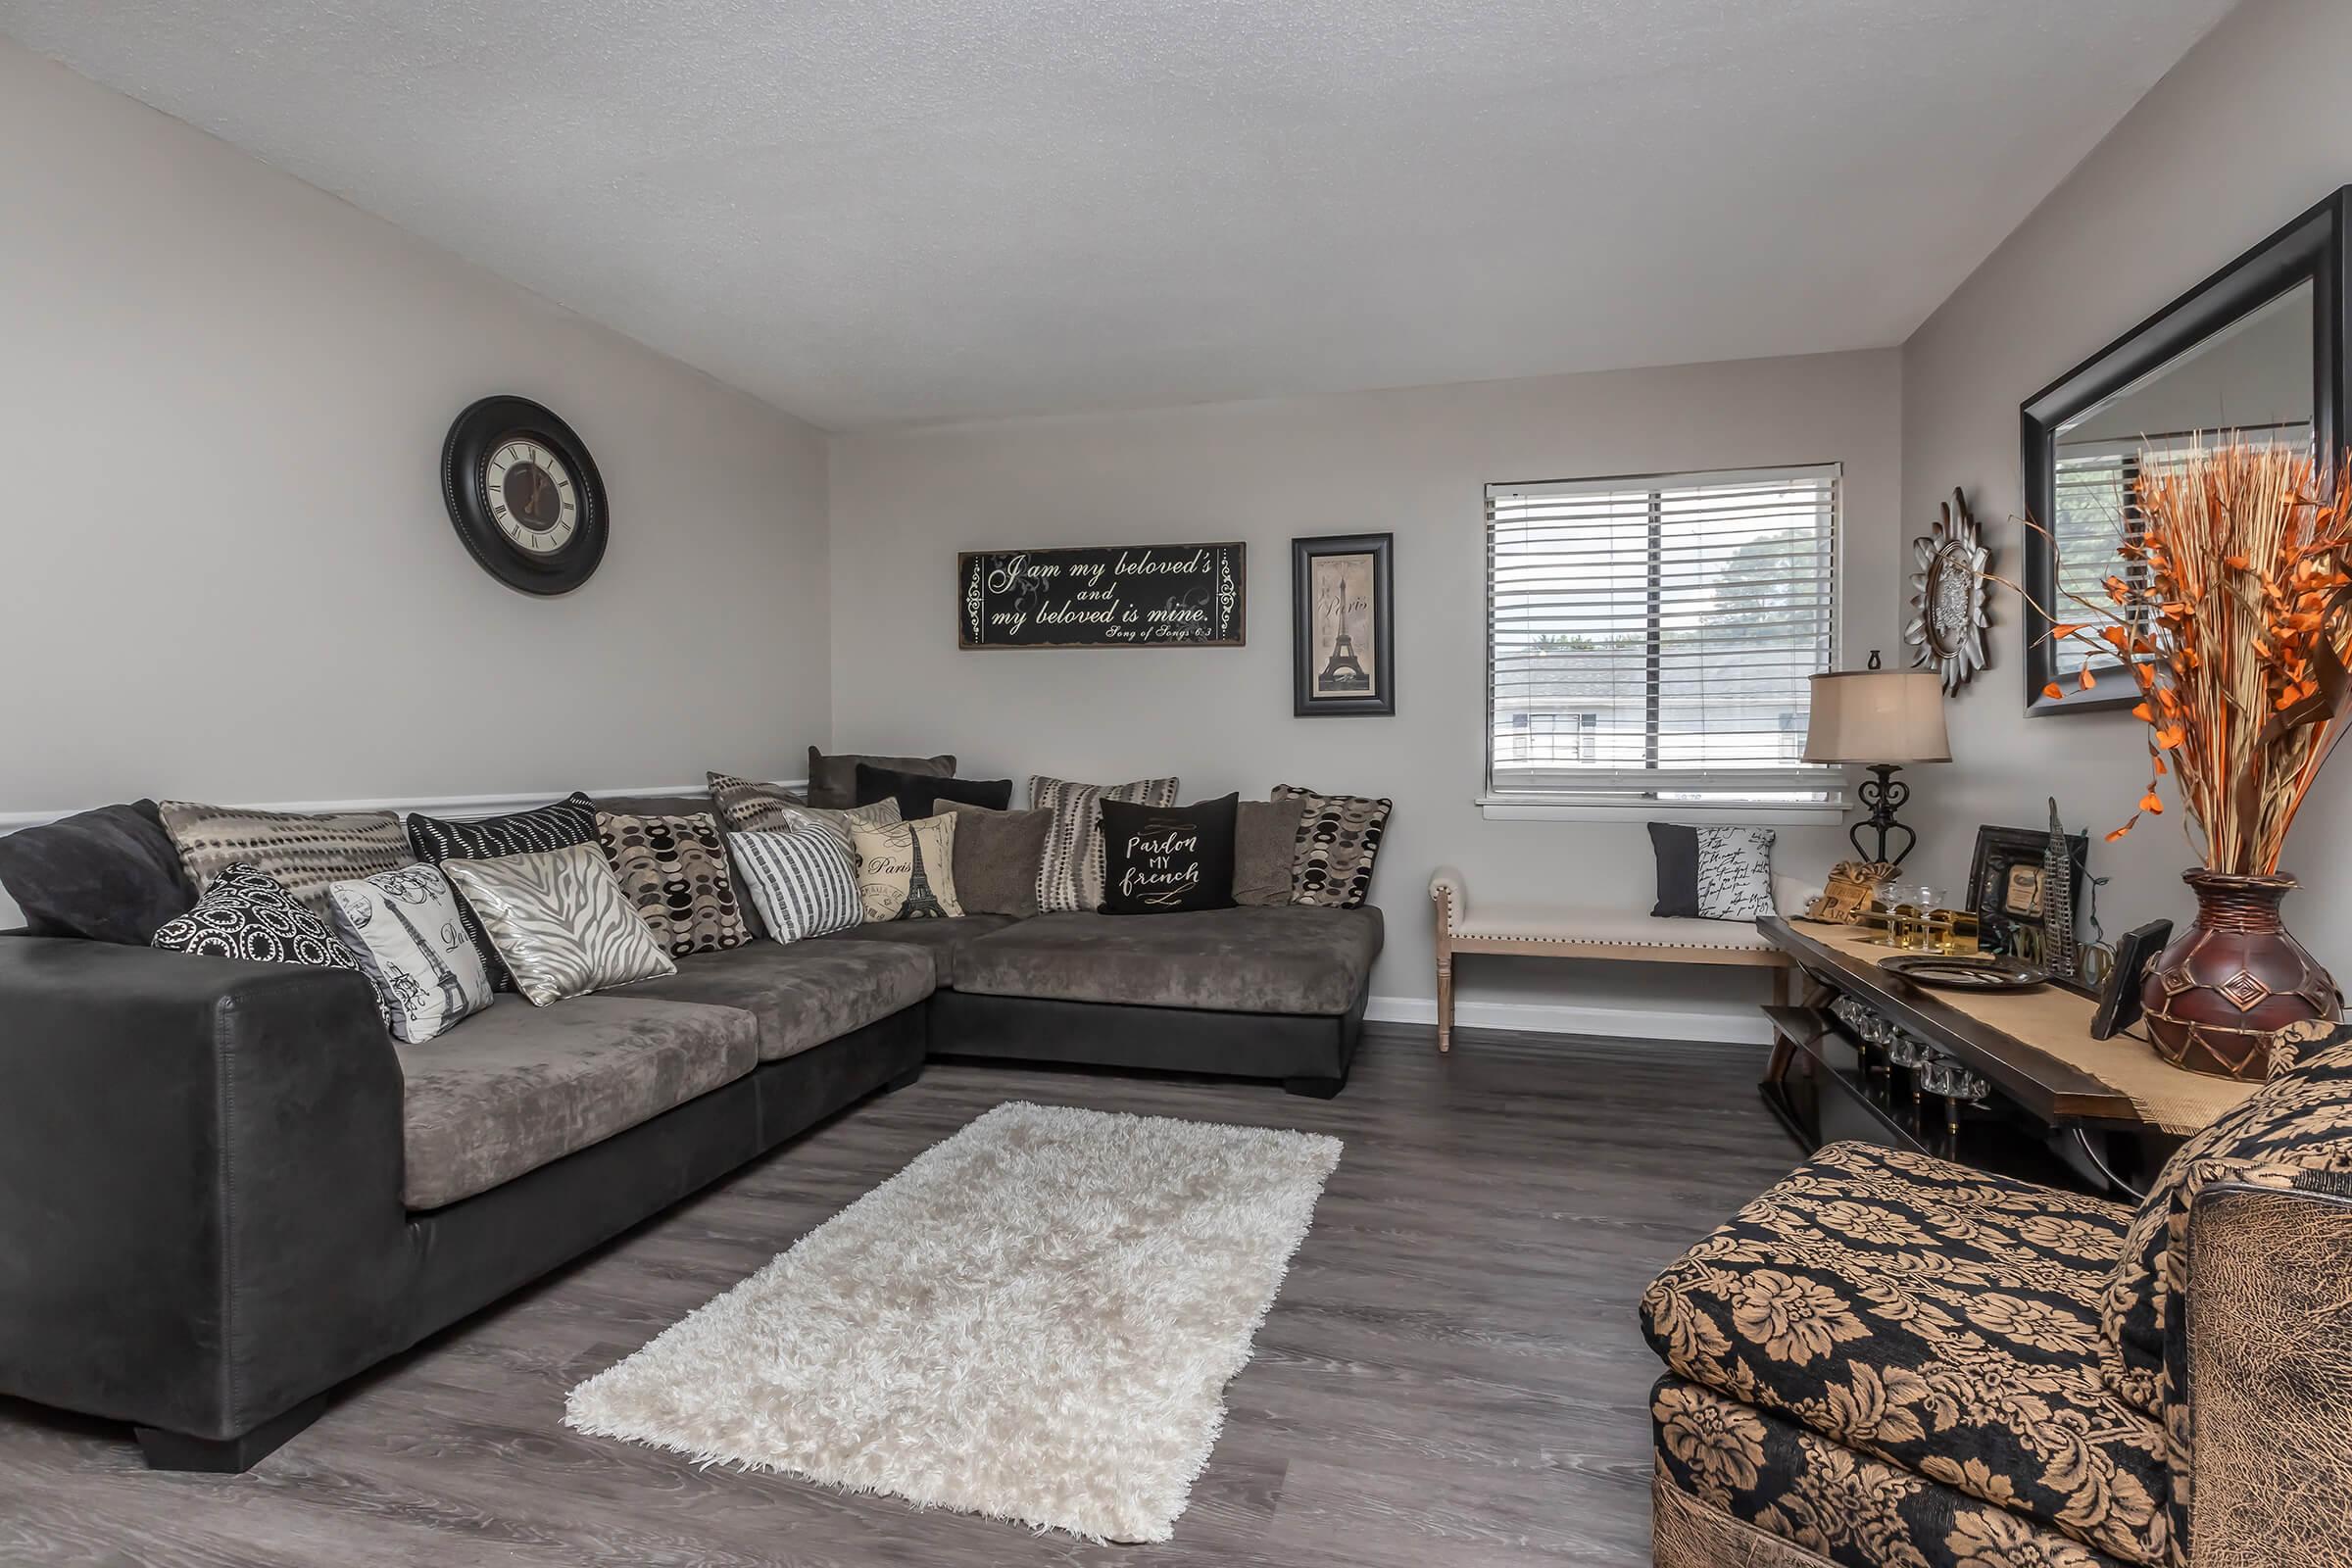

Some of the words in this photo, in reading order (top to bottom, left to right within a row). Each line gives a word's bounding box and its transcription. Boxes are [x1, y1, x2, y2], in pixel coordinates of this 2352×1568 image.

[987, 554, 1027, 595] I
[1027, 564, 1062, 578] am
[1068, 563, 1105, 588] my
[1113, 548, 1212, 576] beloved's
[1076, 581, 1118, 601] and
[990, 612, 1028, 636] my
[1035, 599, 1120, 624] beloved
[1121, 603, 1140, 623] is
[1146, 602, 1208, 623] mine.
[1104, 624, 1137, 642] Song
[1140, 626, 1155, 642] of
[1154, 623, 1191, 642] Songs
[1125, 831, 1198, 859] Pardon
[867, 856, 912, 875] Paris
[1149, 855, 1171, 870] MY
[1118, 861, 1200, 898] french
